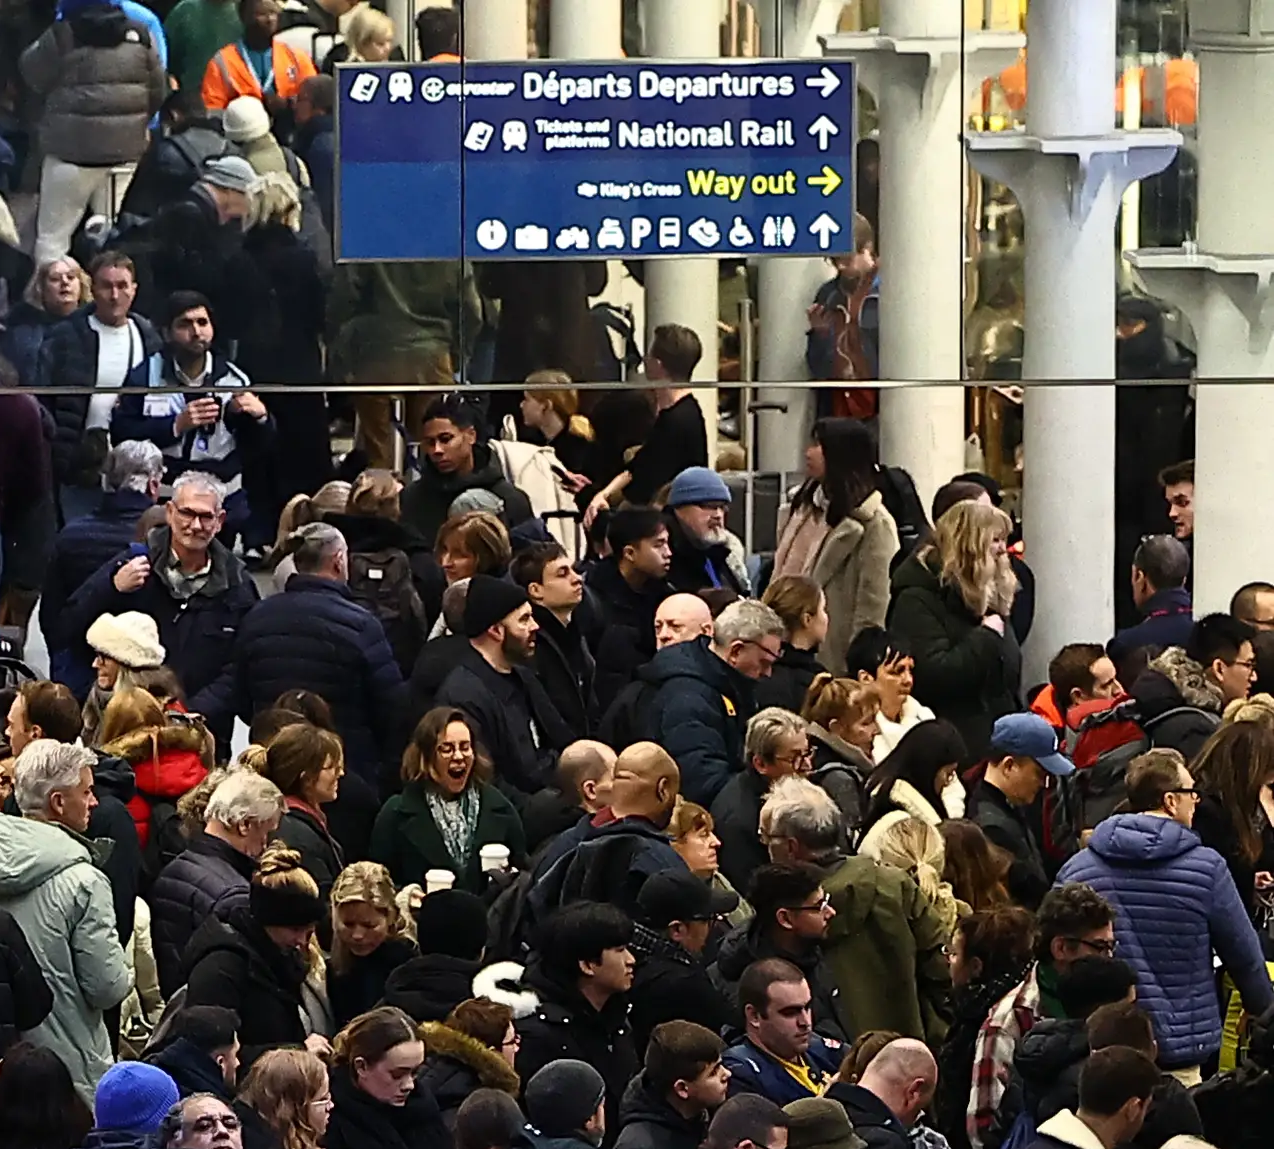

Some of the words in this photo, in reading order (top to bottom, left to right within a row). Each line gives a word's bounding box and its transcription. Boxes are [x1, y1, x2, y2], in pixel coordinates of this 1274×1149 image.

[523, 70, 632, 105] Départs
[639, 70, 795, 104] Departures
[535, 118, 583, 134] Tickets
[584, 118, 611, 133] and
[618, 120, 734, 148] National
[741, 119, 795, 147] Rail
[545, 134, 611, 152] platforms
[599, 182, 642, 201] King's
[642, 181, 683, 198] Cross
[686, 169, 746, 201] Way
[751, 170, 796, 195] out
